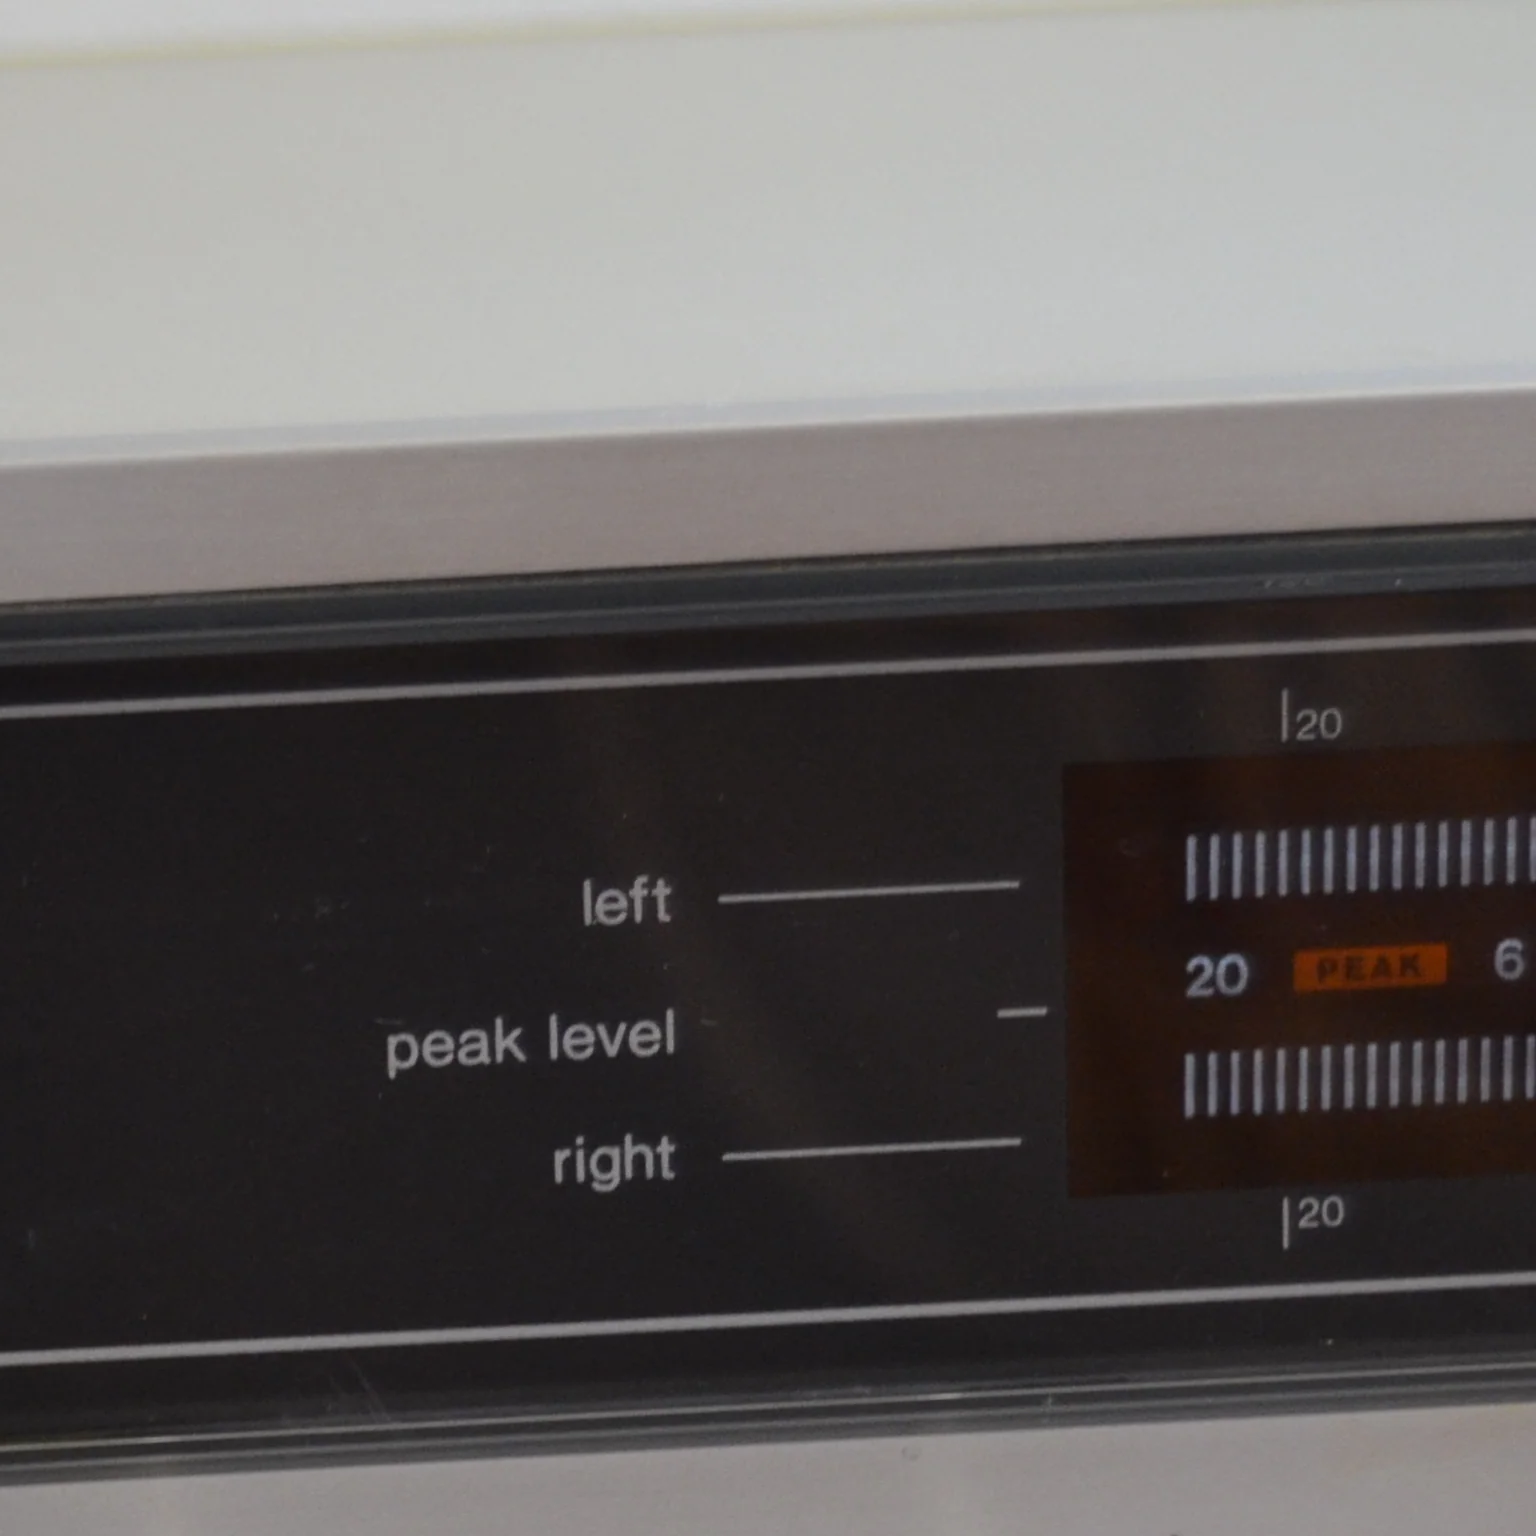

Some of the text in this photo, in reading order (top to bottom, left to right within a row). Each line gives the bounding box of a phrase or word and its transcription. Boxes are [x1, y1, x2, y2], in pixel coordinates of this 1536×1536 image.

[1295, 706, 1344, 742] 20
[582, 874, 673, 927] left
[1185, 937, 1526, 998] 20 PEAK 6
[386, 1007, 676, 1081] peak level
[553, 1132, 677, 1194] right
[1297, 1194, 1346, 1230] 20
